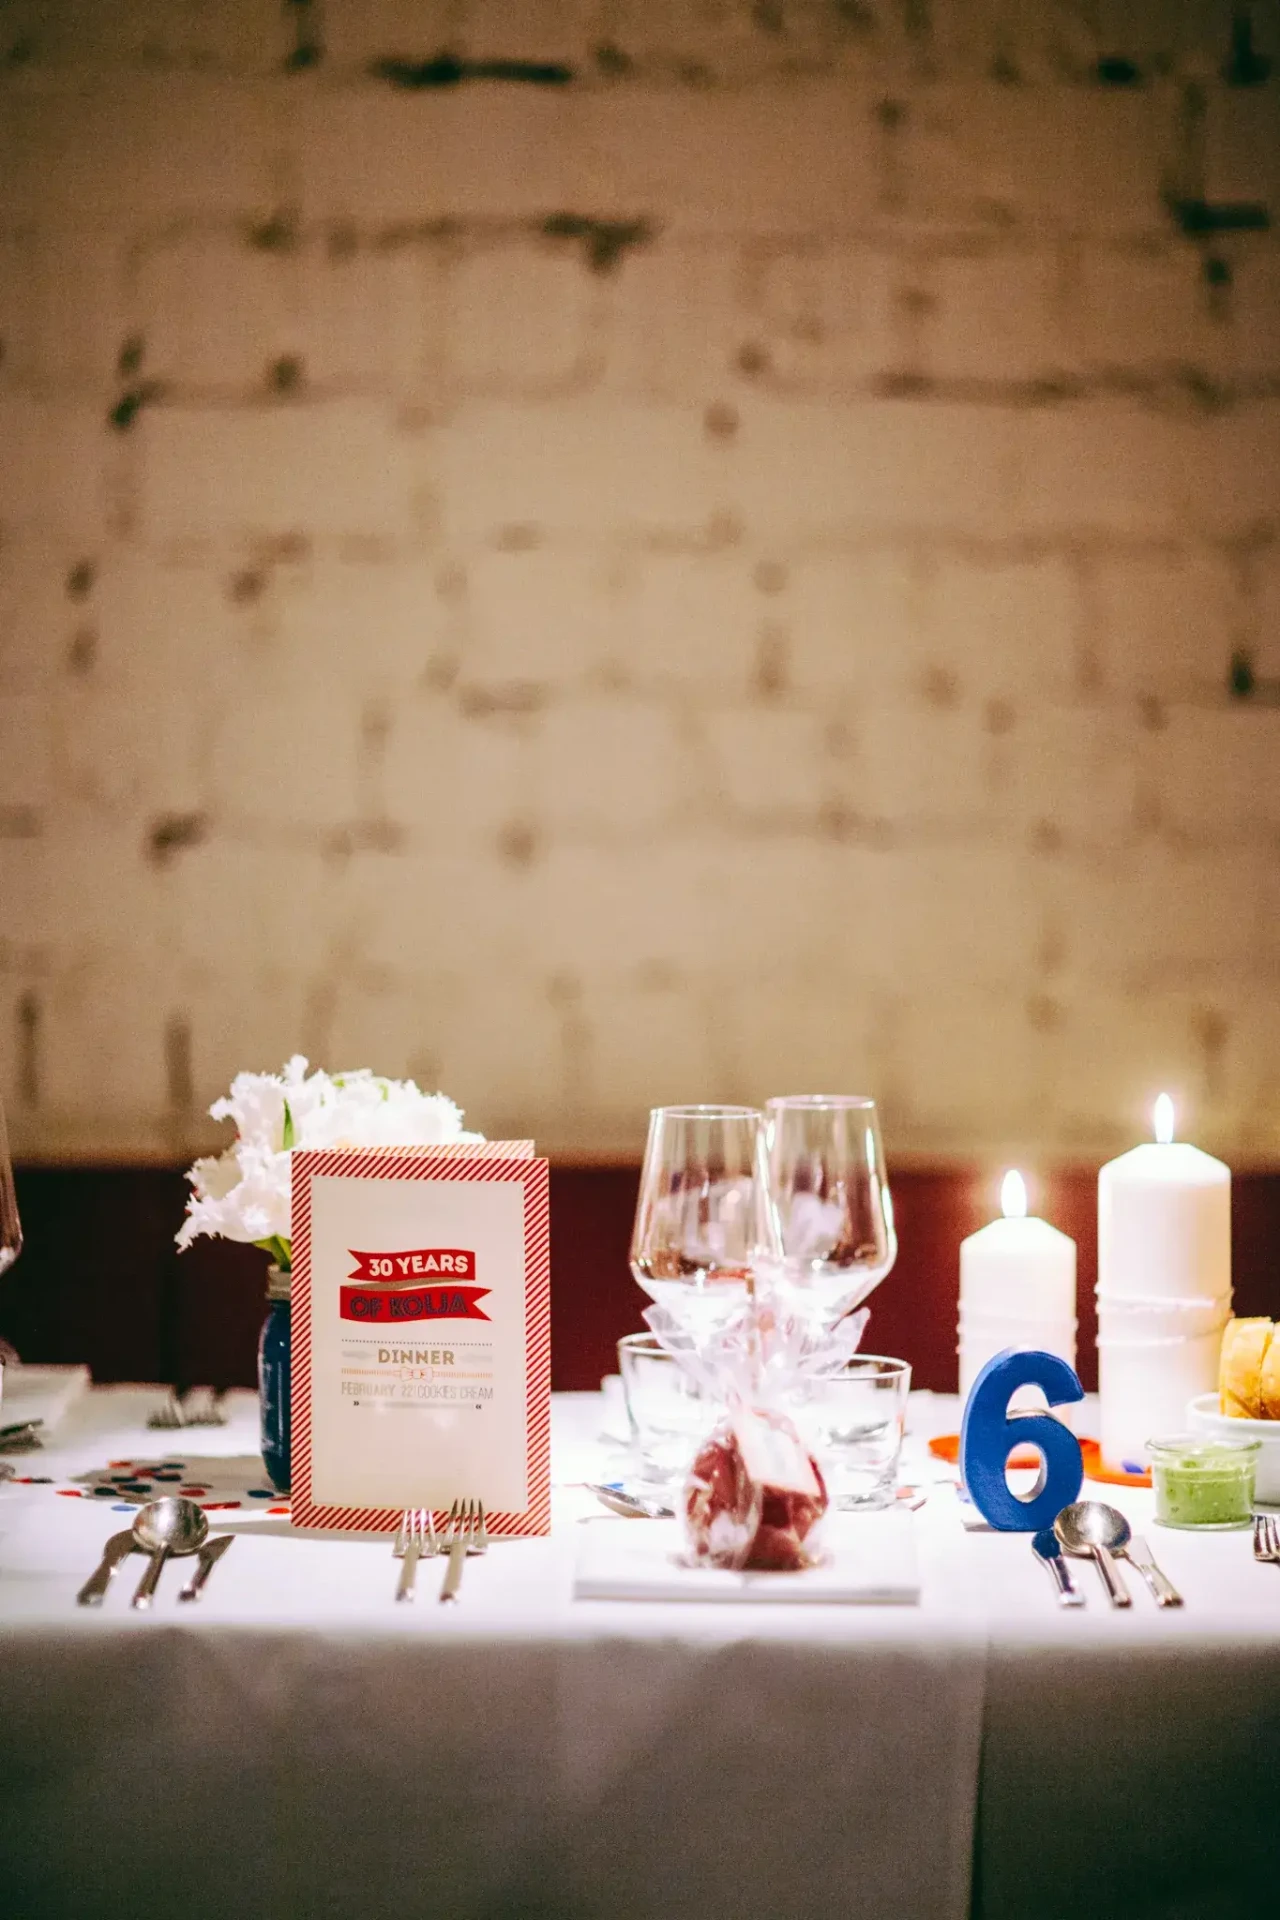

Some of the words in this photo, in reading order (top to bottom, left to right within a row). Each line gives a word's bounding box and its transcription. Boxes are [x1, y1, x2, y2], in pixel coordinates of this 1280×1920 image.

[369, 1258, 393, 1276] 30
[396, 1254, 468, 1275] YEARS
[350, 1296, 382, 1318] OF
[389, 1293, 468, 1318] KOLJA
[378, 1348, 455, 1365] DINNER
[341, 1381, 396, 1397] FEBRUARY
[417, 1384, 457, 1399] COOKIES
[460, 1385, 494, 1400] CREAM
[959, 1346, 1085, 1531] 6
